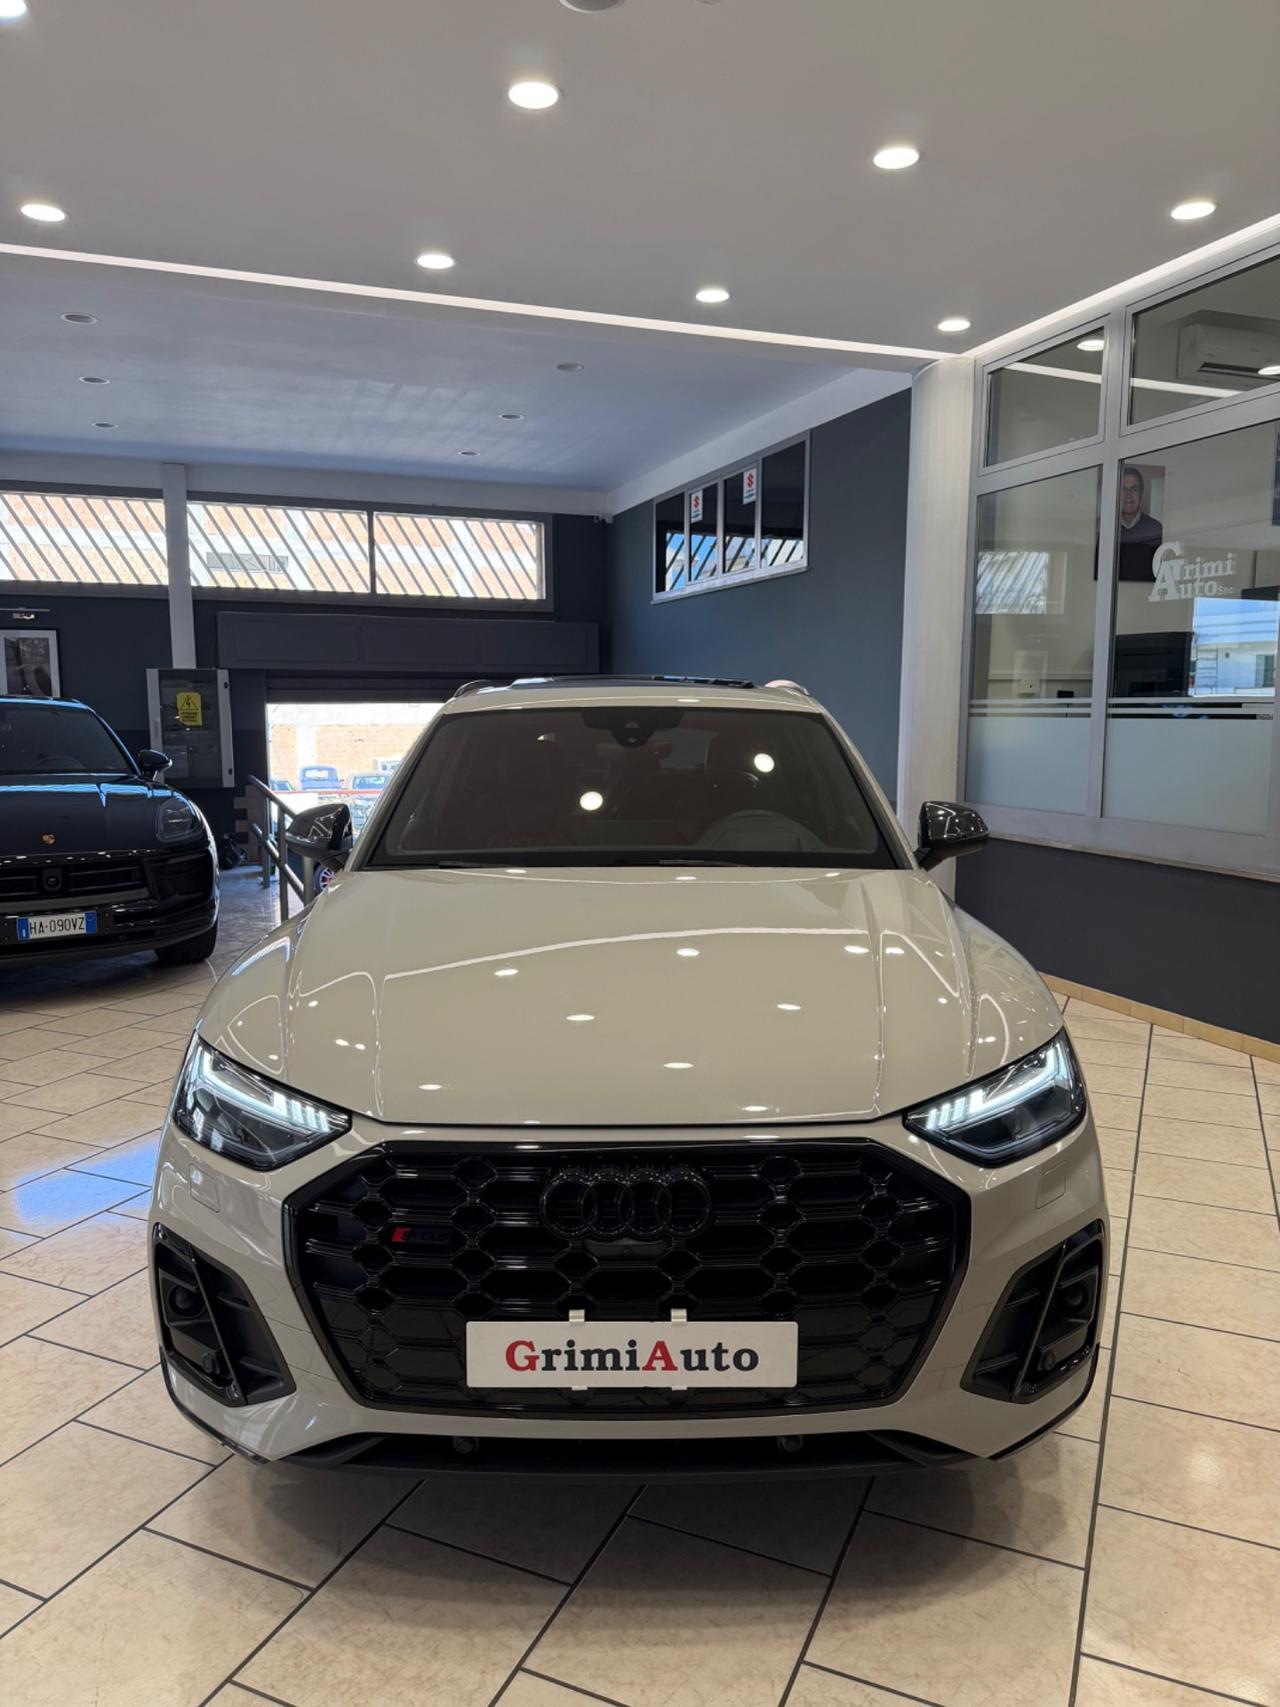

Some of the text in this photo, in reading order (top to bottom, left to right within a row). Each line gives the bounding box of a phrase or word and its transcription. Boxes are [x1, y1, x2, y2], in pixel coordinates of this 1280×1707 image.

[1152, 541, 1234, 580] Grimi
[1148, 561, 1217, 602] Auto
[505, 1339, 759, 1372] GrimiAuto
